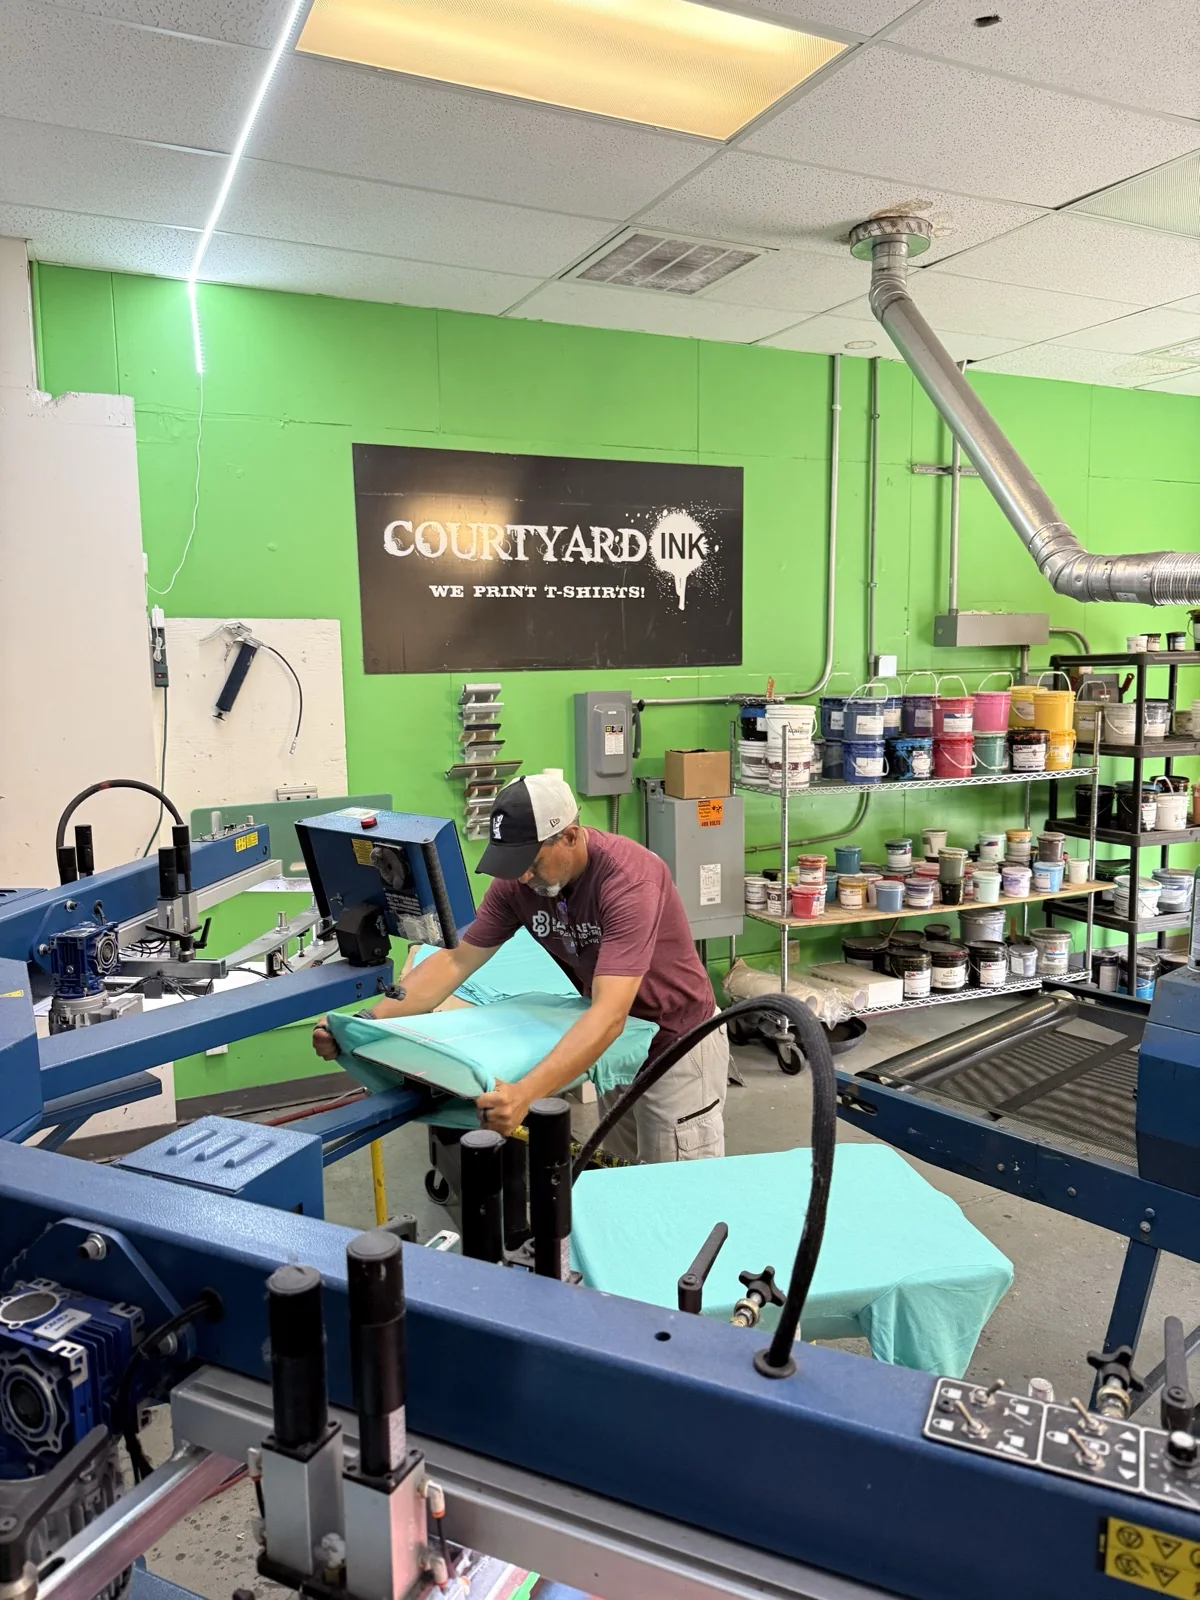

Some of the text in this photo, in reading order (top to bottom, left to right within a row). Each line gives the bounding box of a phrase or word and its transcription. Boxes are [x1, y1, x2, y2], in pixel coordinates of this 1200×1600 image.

[384, 520, 706, 563] COURTYARD INK
[429, 585, 646, 599] WE PRINT T-SHIRTS!
